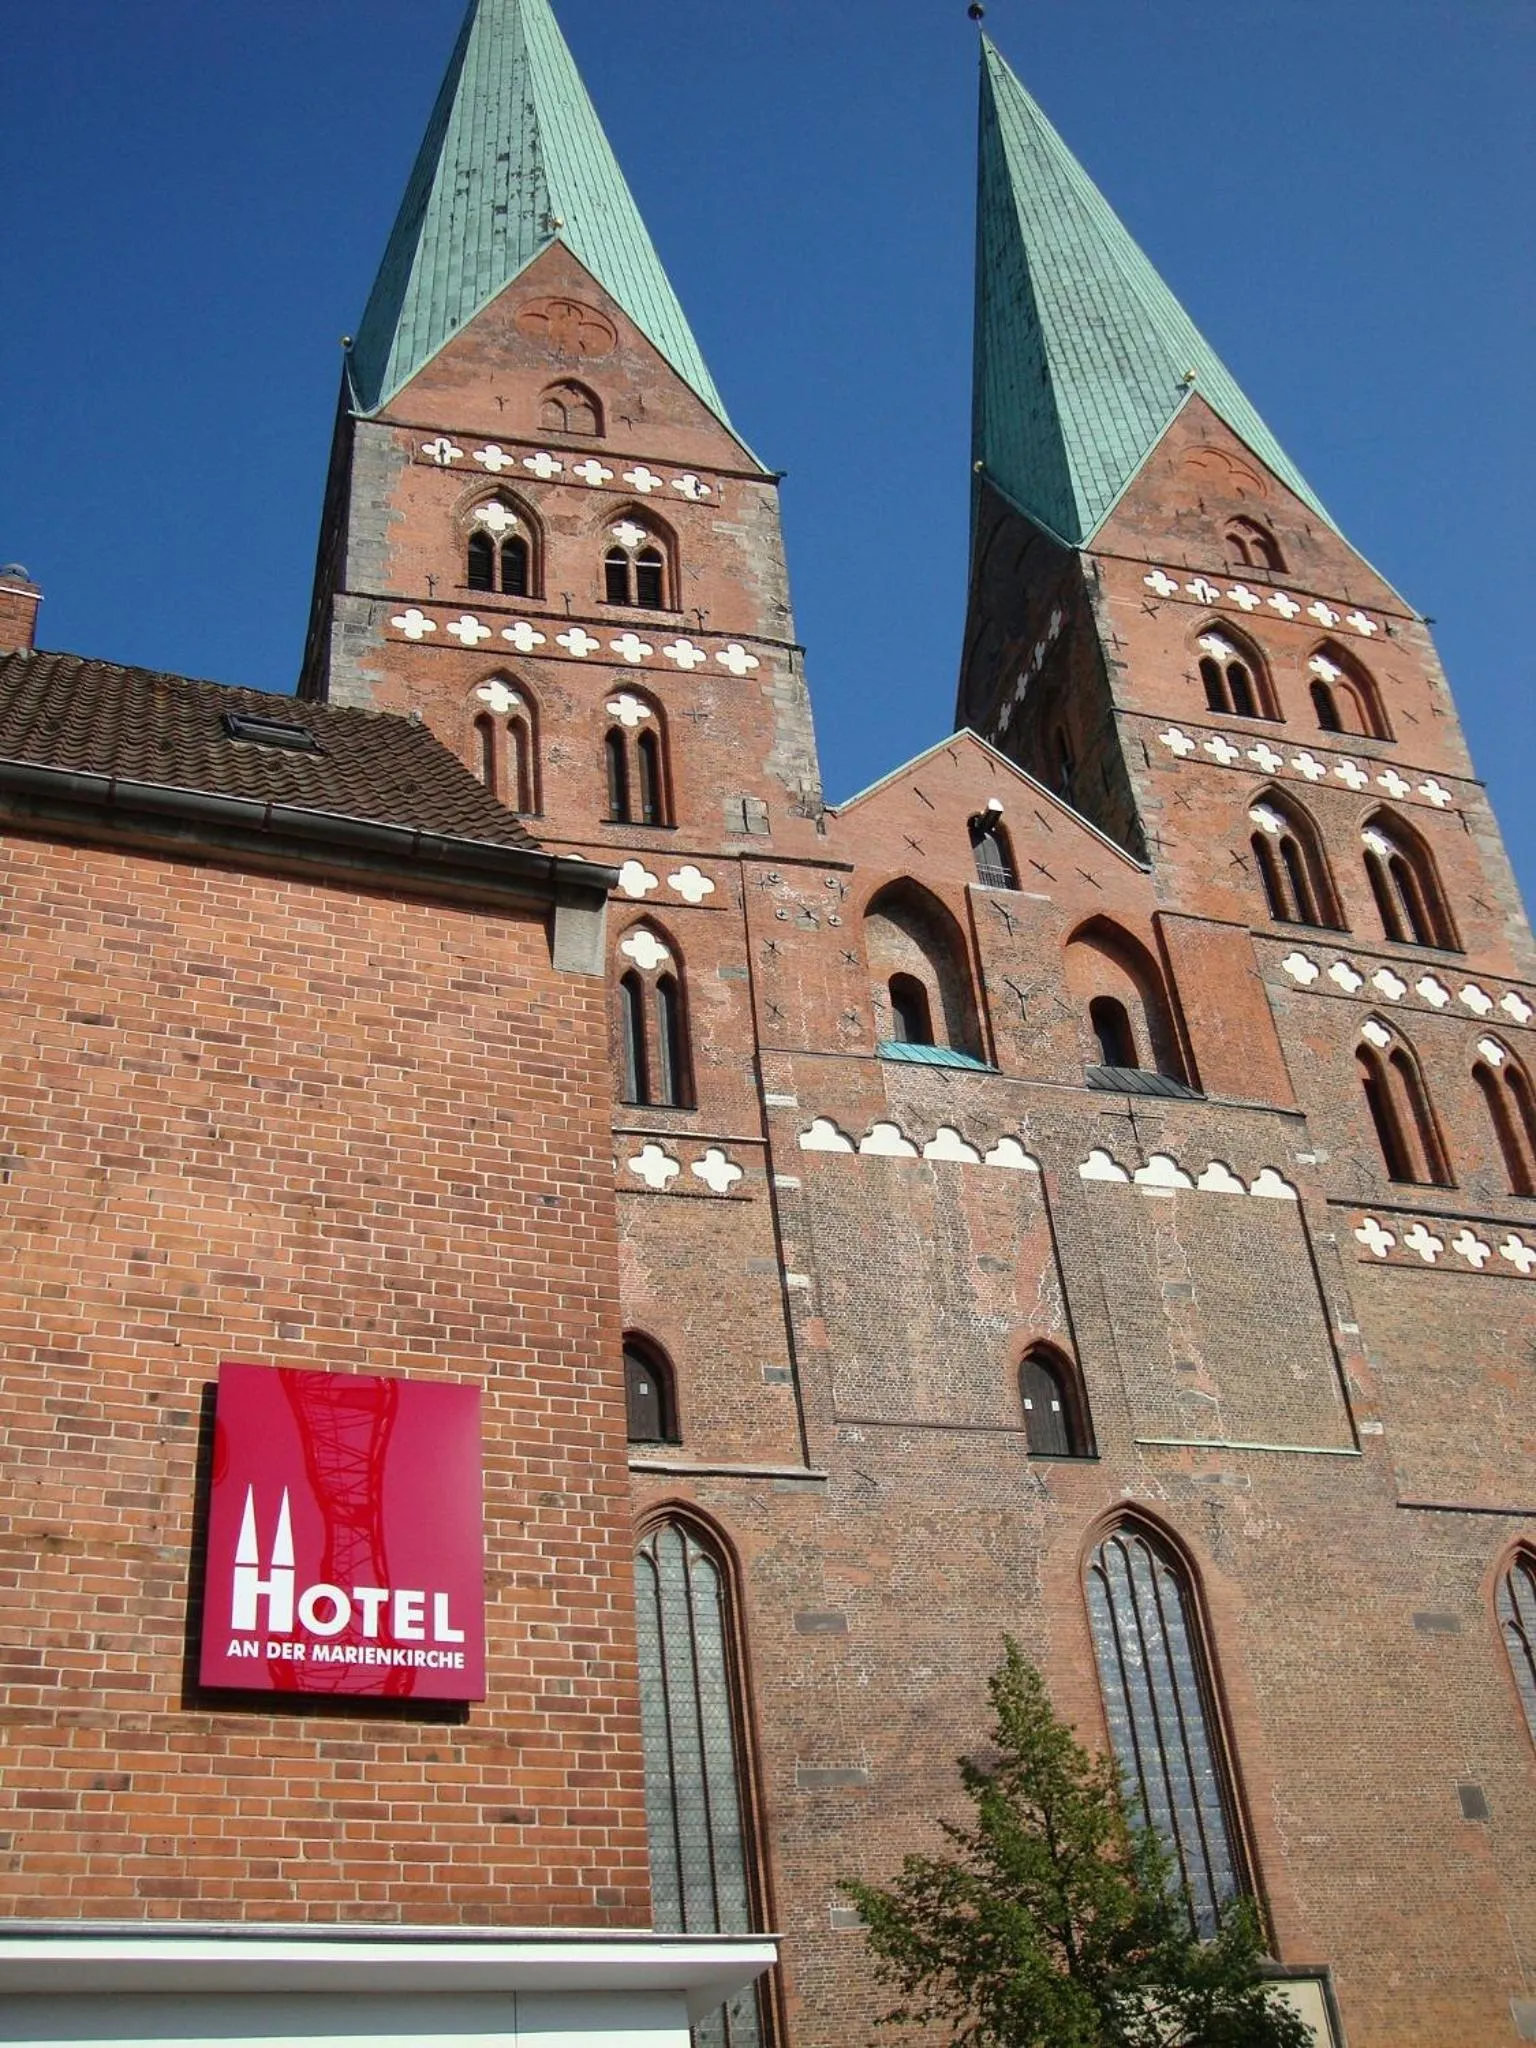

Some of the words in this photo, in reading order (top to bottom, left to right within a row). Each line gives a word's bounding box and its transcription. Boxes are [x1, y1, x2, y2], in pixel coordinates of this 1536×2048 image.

[231, 1566, 465, 1642] HOTEL
[227, 1640, 259, 1658] AN
[266, 1642, 306, 1660] DER
[312, 1645, 465, 1669] MARIENKIRCHE
